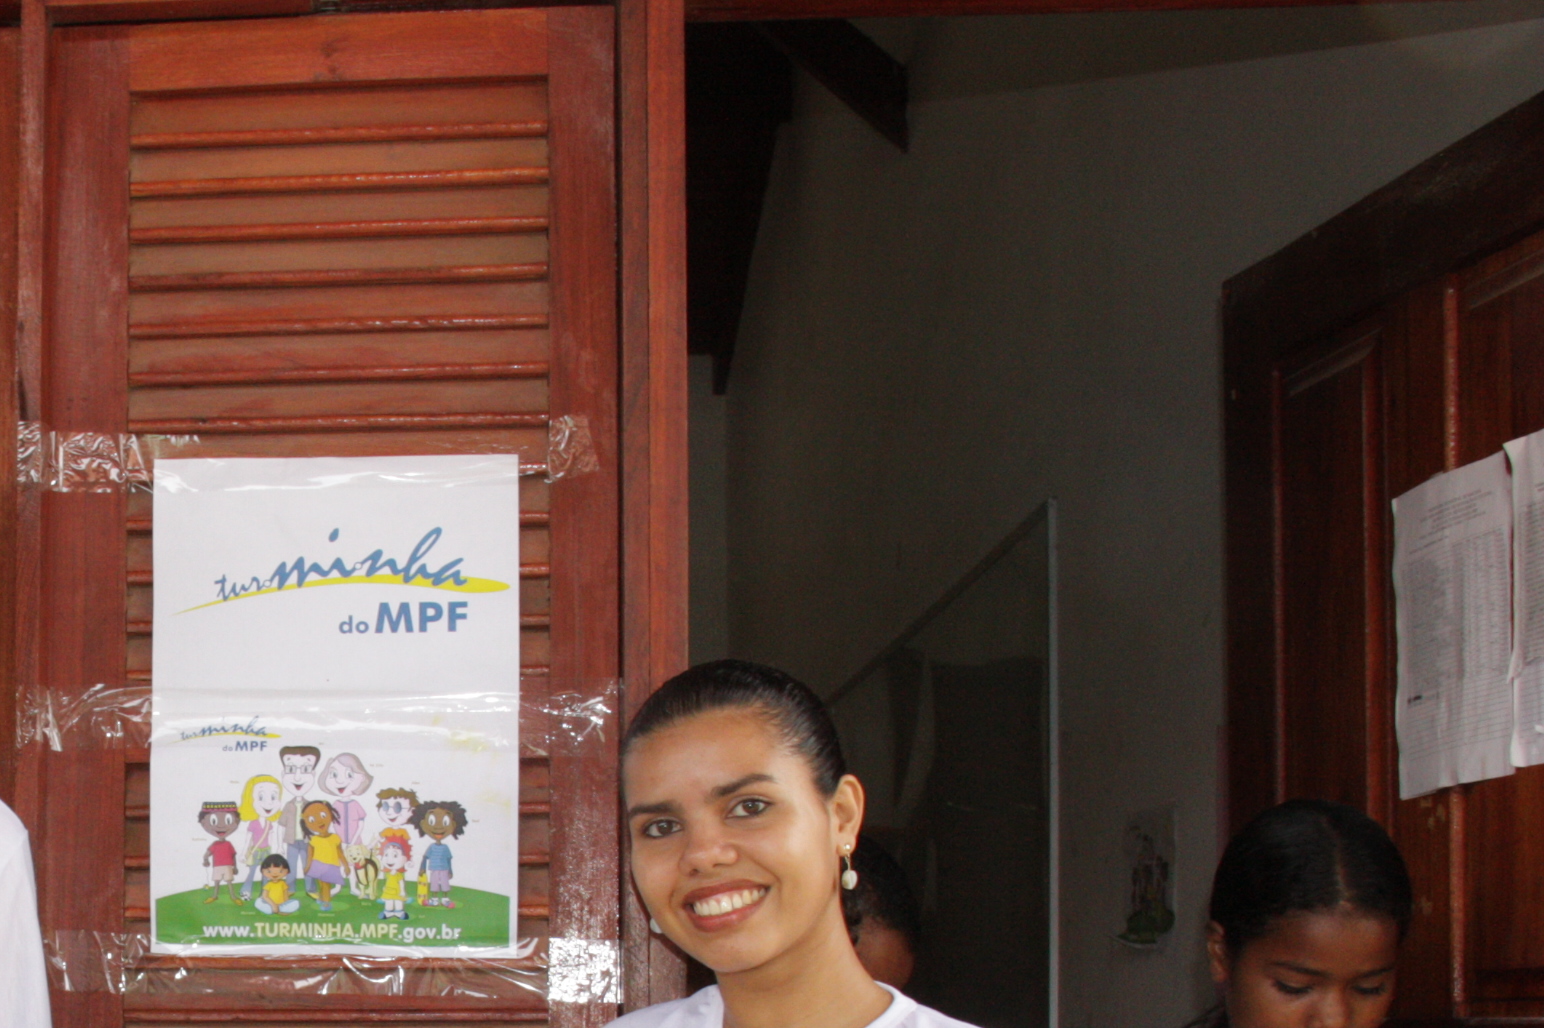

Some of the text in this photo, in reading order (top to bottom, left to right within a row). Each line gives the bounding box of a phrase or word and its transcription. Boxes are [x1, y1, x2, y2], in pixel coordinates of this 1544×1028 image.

[214, 526, 468, 601] turminha
[339, 601, 468, 634] do MPF
[180, 715, 268, 741] turminha
[235, 741, 268, 752] MPF
[203, 922, 462, 943] www.TURMINHA.MPF.gov.br
